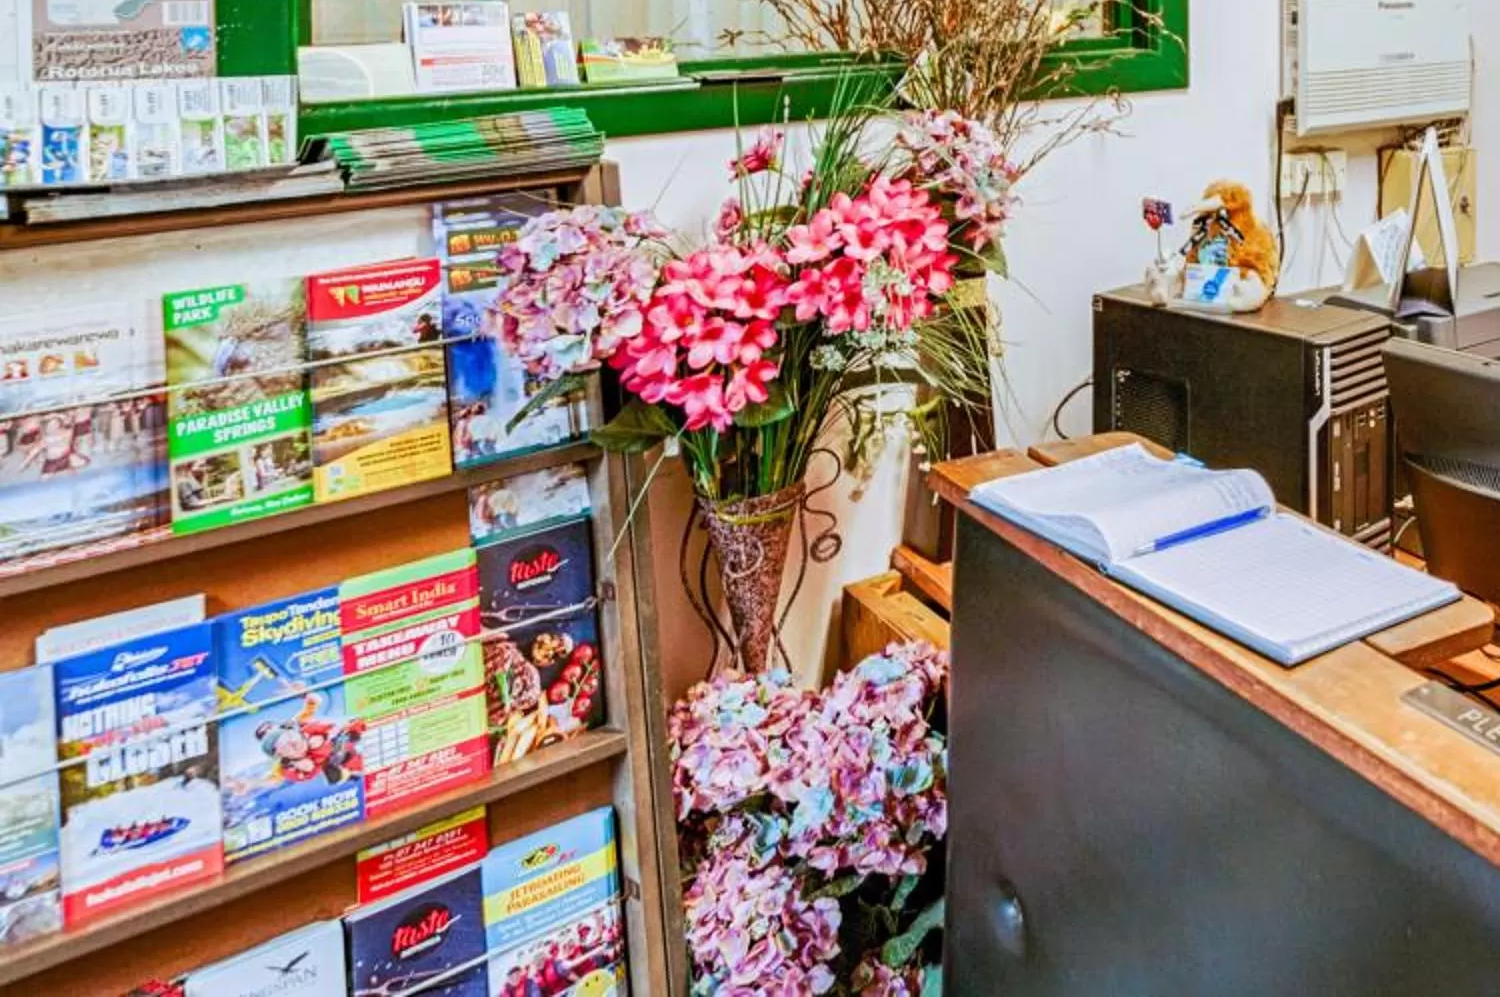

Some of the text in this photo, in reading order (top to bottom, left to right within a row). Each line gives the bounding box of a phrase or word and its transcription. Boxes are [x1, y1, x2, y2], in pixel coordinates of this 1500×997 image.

[48, 62, 199, 79] Rotorua Lakes
[171, 286, 238, 312] WILDLIFE
[172, 306, 213, 326] PARK
[175, 391, 305, 438] PARADISE VALLEY
[212, 415, 277, 444] SPRINGS
[355, 579, 457, 620] Smart India
